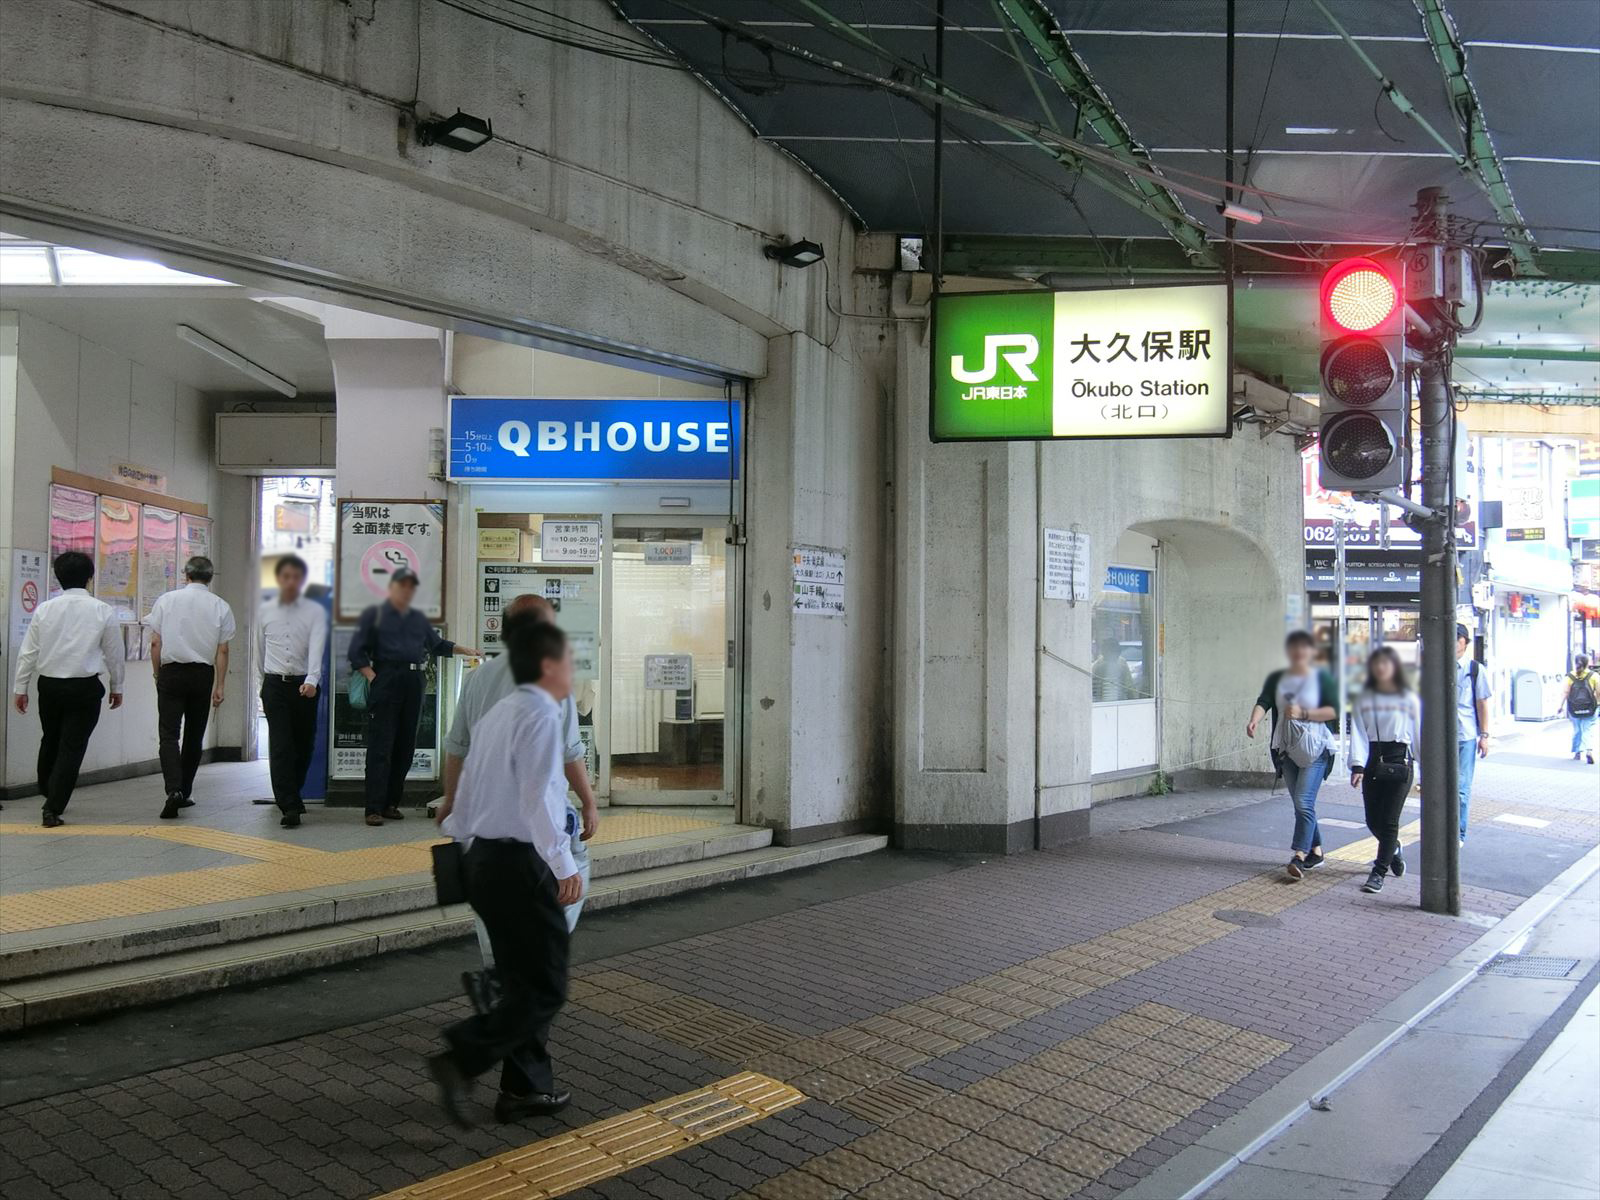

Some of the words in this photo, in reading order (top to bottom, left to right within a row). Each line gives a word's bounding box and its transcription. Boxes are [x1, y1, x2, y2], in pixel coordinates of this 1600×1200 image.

[1070, 329, 1211, 364] 大久保駅
[951, 334, 1039, 384] JR
[962, 386, 1028, 400] JR東日本
[1071, 378, 1133, 398] Ōkubo
[1140, 380, 1209, 396] Station
[352, 507, 390, 519] 当駅は
[352, 522, 431, 537] 全面禁煙です。
[555, 525, 588, 533] 営業時間
